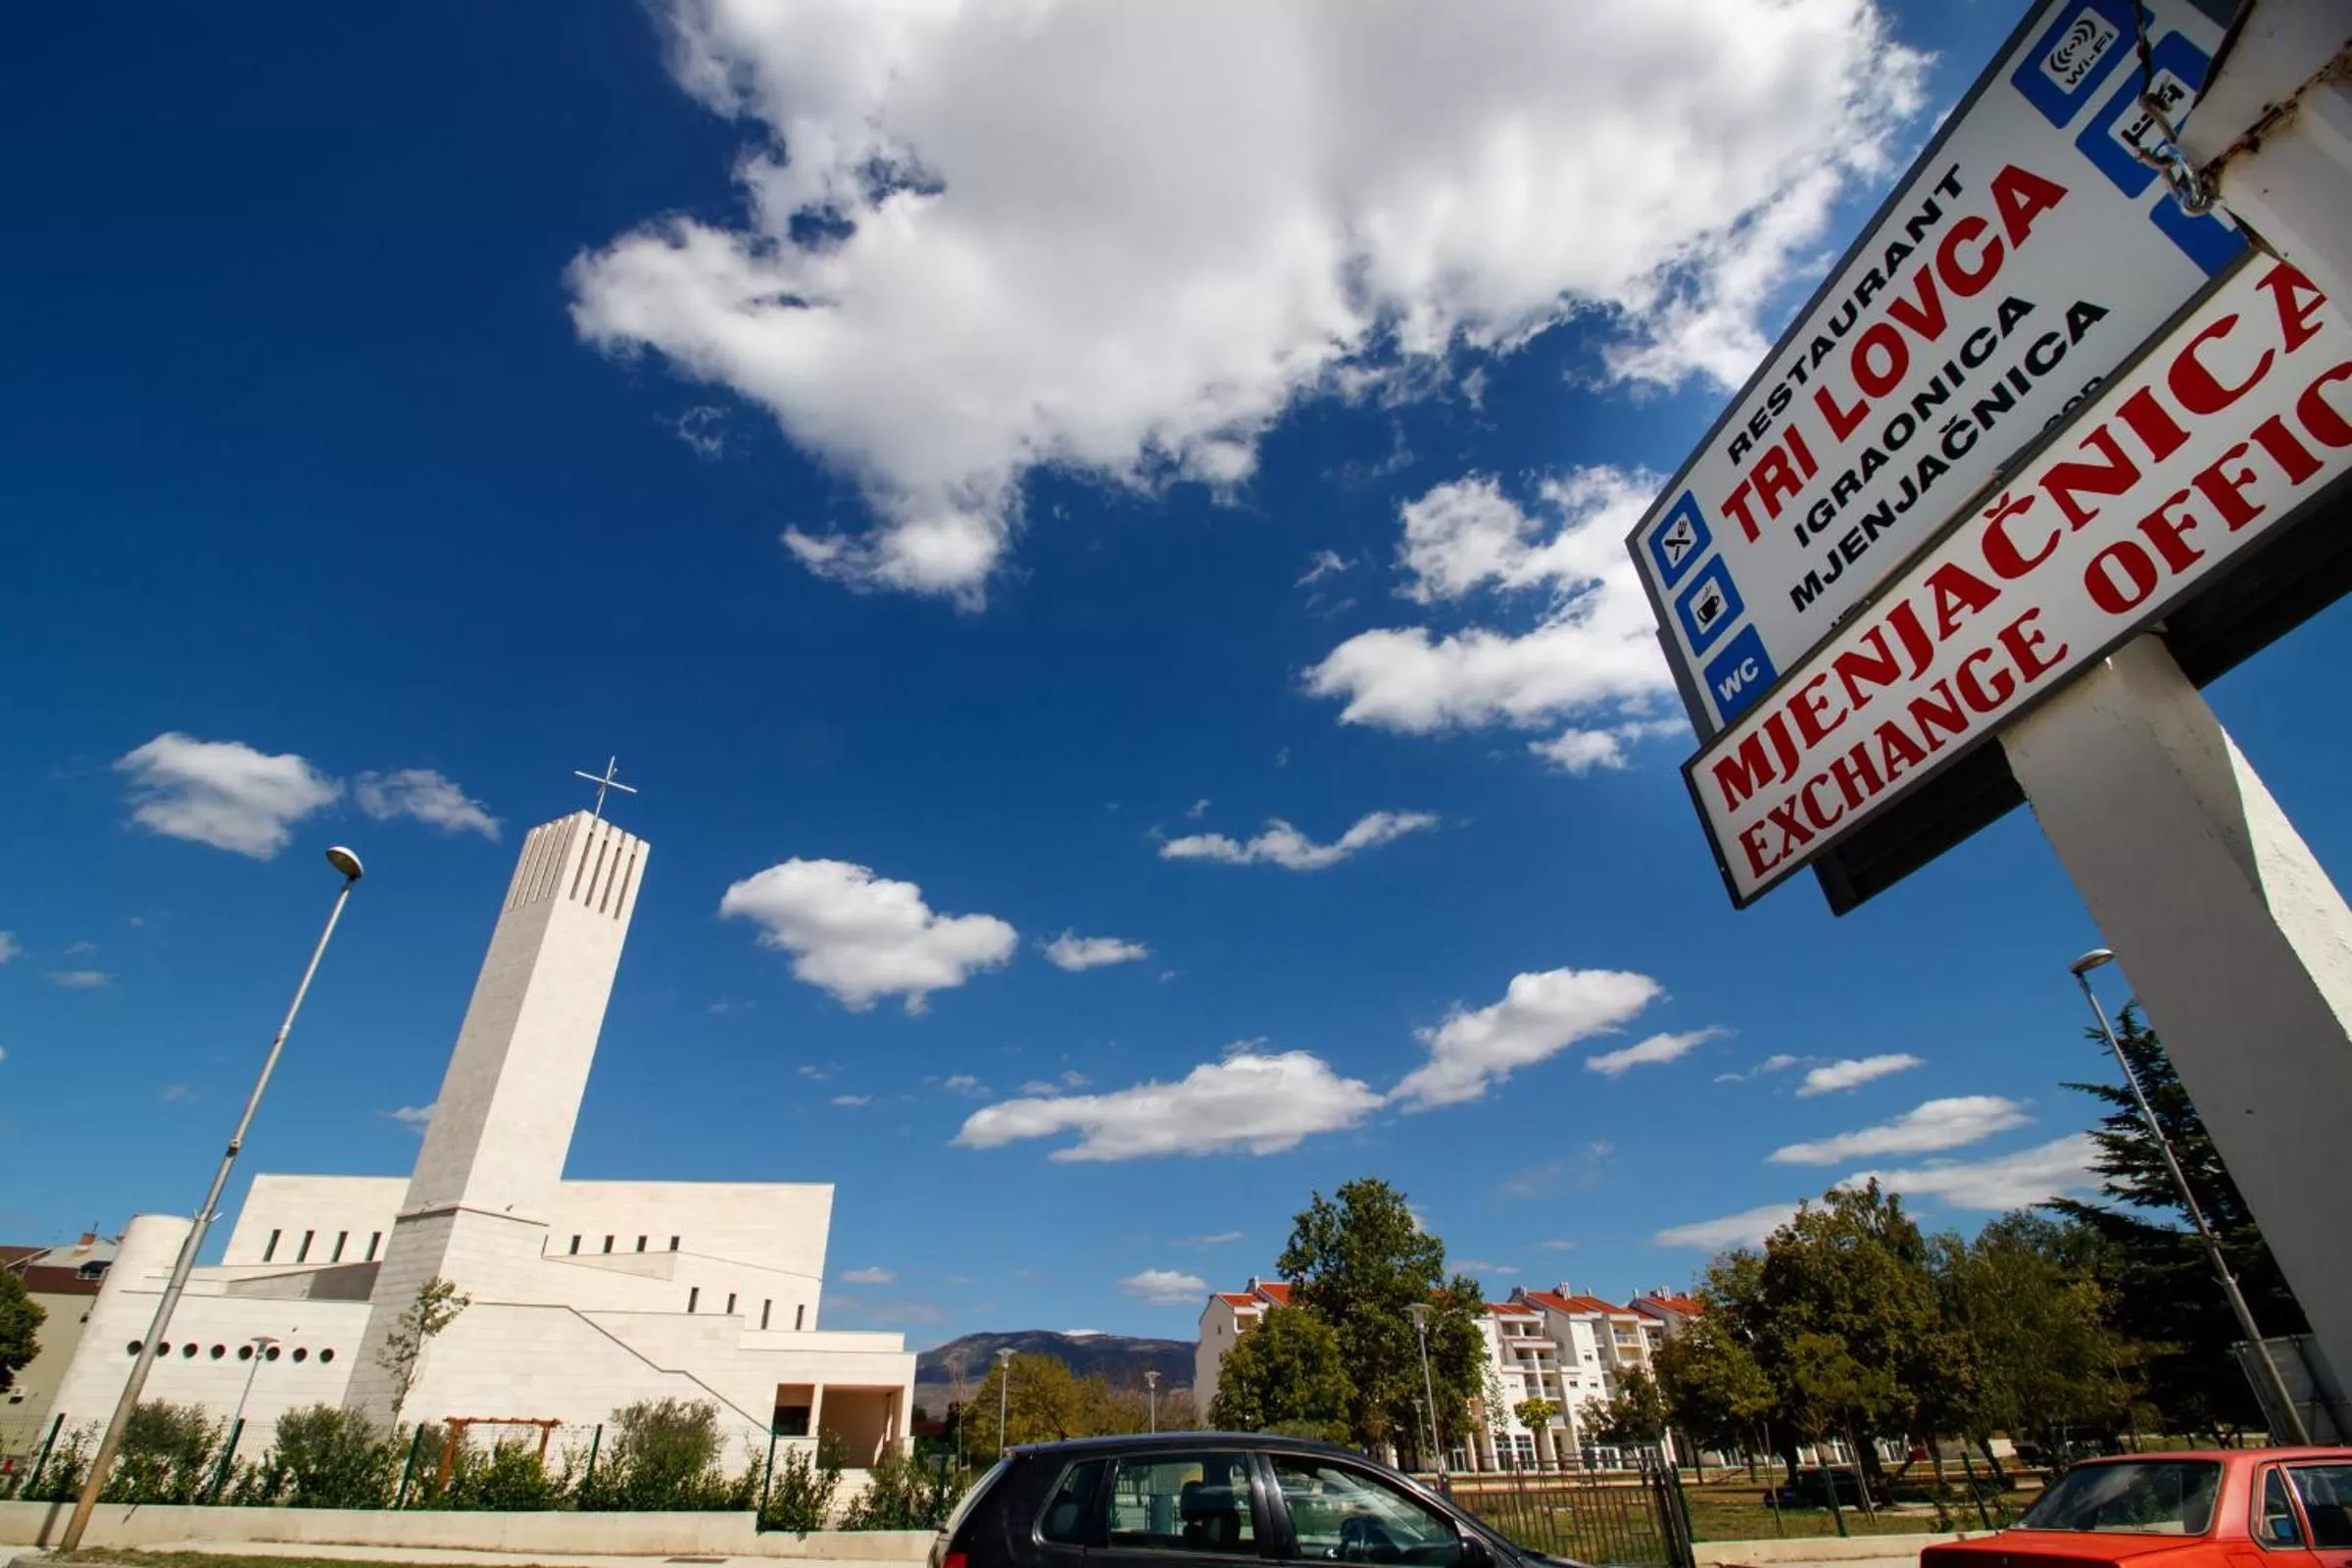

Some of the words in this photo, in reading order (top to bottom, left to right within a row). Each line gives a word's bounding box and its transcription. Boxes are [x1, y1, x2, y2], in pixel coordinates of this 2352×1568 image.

[1722, 425, 1819, 543] TRI
[1814, 165, 2069, 442] LOVCA
[1728, 163, 1963, 466] RESTAURANT
[1789, 300, 2110, 613] MJENJAČNICA
[1794, 296, 2035, 548] IGRAONICA
[1712, 262, 2328, 811] MJENJAČNICA
[1718, 656, 1759, 702] WC
[1740, 607, 2068, 878] EXCHANGE
